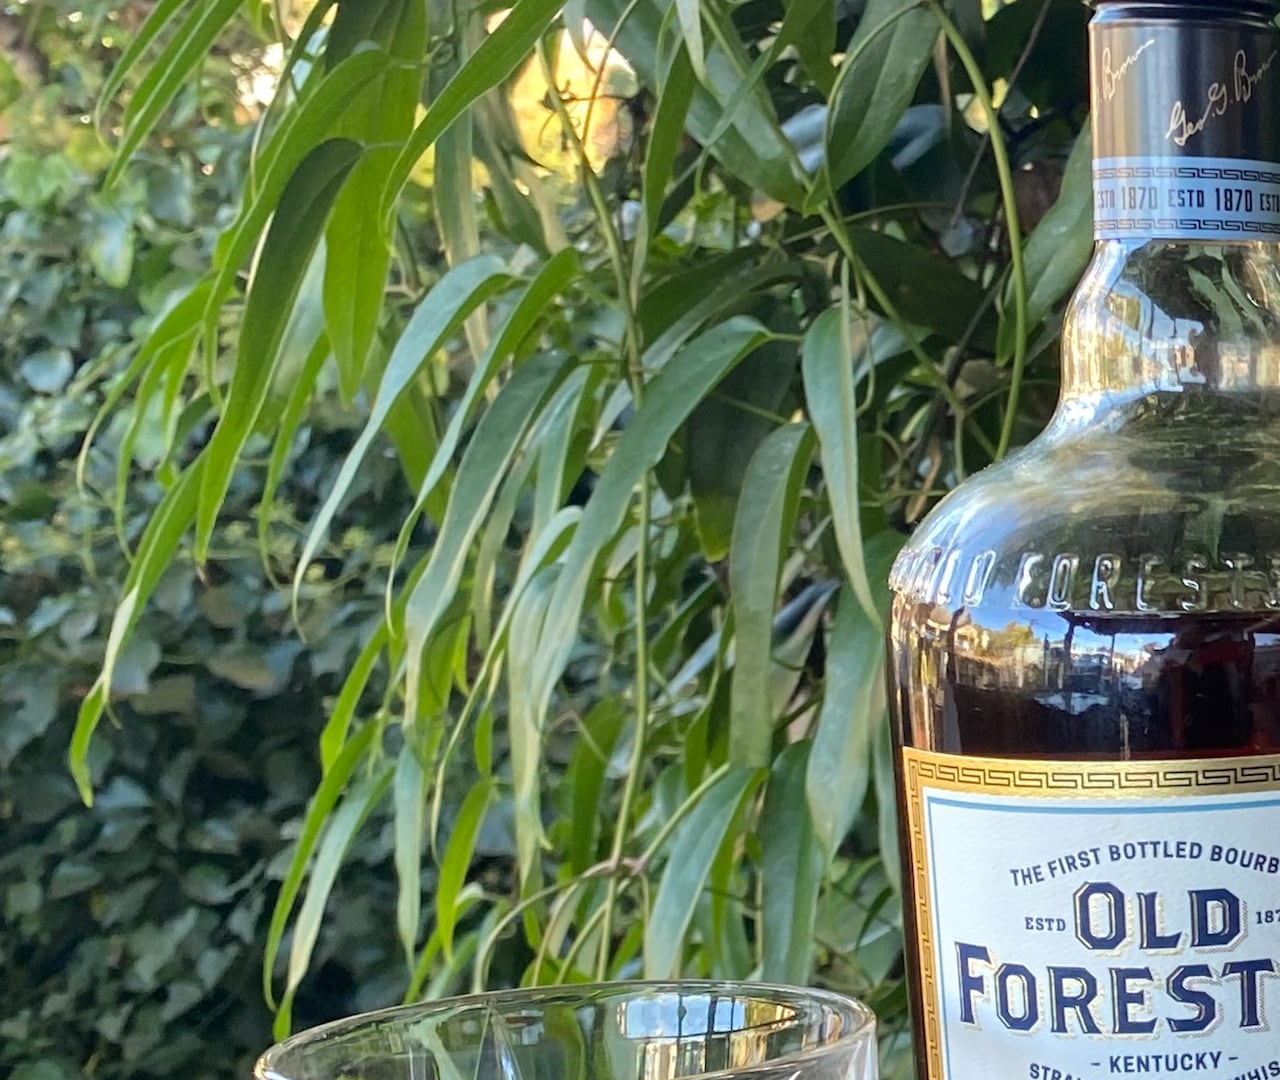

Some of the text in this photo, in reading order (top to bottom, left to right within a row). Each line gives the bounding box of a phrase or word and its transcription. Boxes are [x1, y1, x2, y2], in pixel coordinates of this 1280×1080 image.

[1168, 188, 1252, 212] ESTD 1870
[1010, 867, 1045, 888] THE
[1048, 848, 1102, 880] FIRST
[1108, 841, 1201, 862] BOTTLED
[1025, 917, 1066, 932] ESTD
[1073, 881, 1248, 956] OLD
[1109, 1051, 1222, 1073] KENTUCKY
